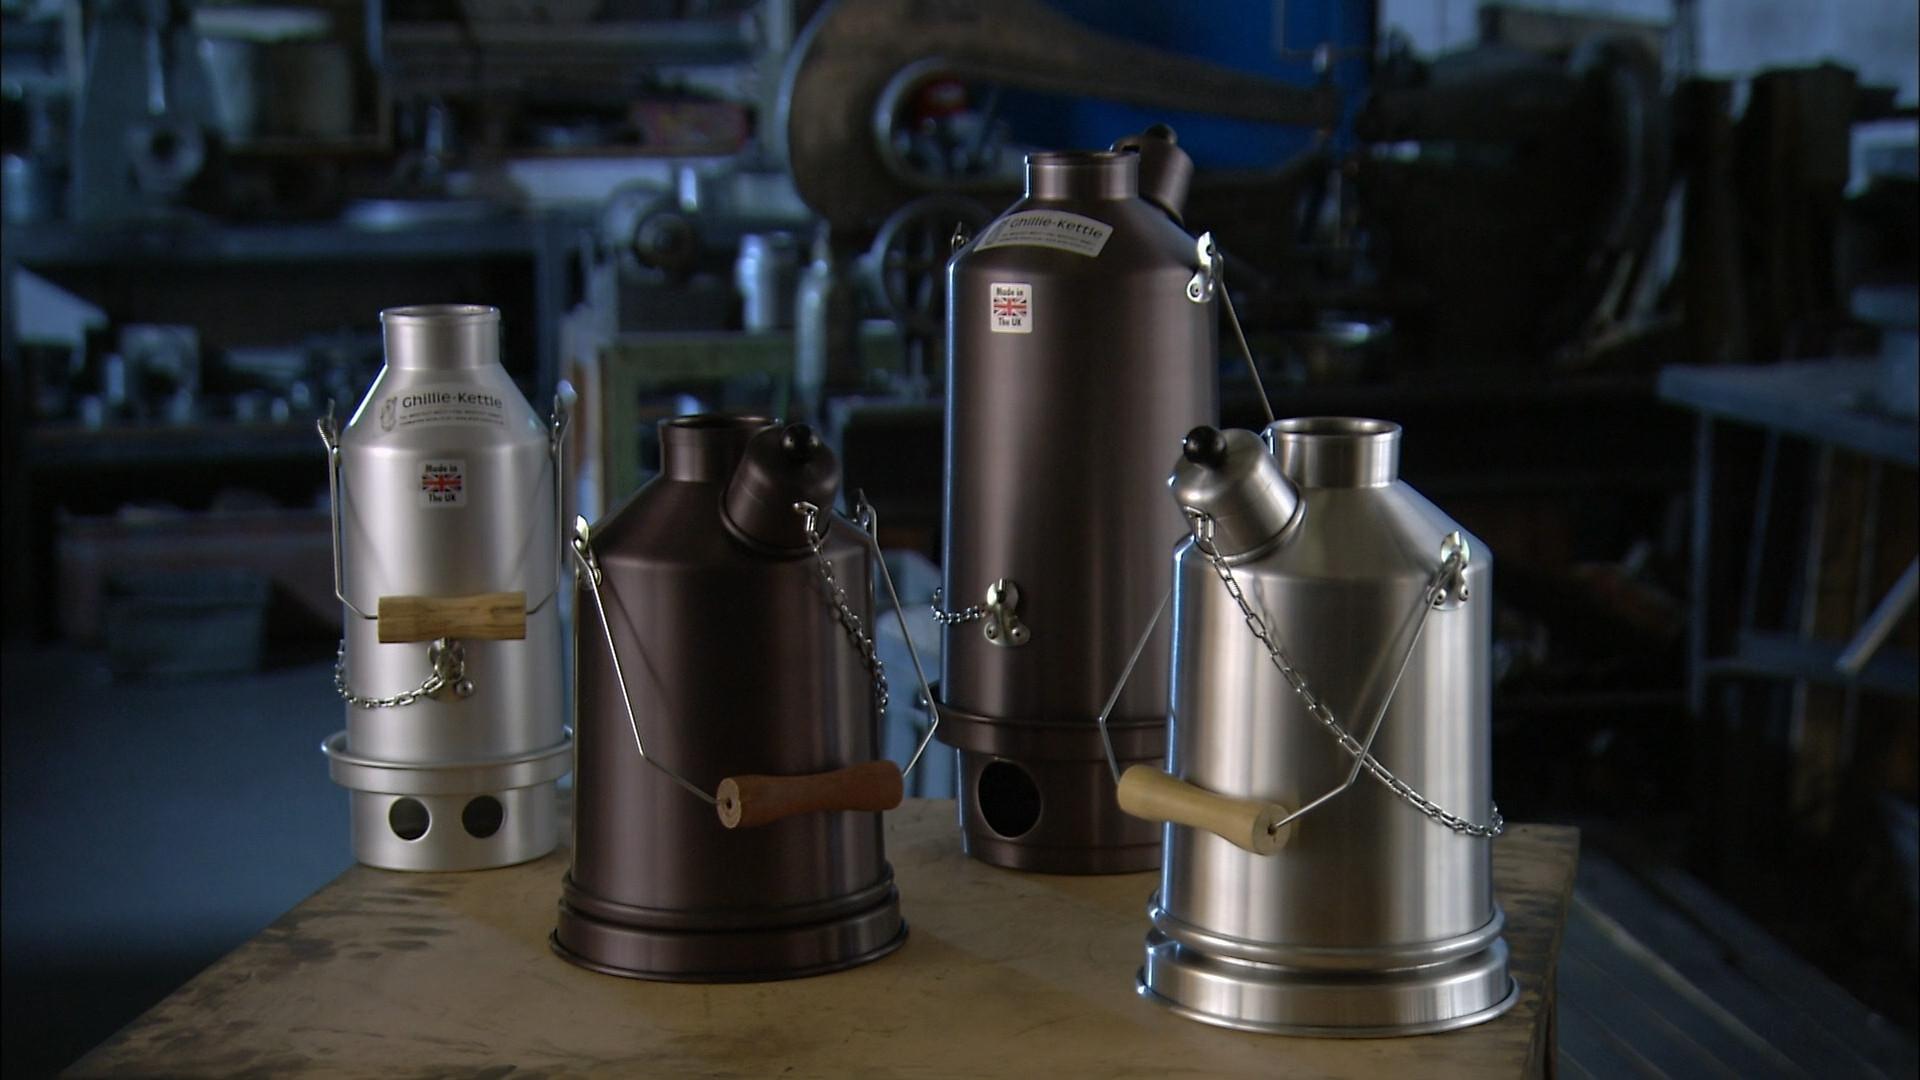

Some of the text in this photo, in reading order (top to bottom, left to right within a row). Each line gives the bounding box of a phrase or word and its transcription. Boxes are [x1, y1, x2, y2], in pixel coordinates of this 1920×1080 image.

[1009, 215, 1103, 238] Ghillie-Kettle
[996, 287, 1024, 296] Made in
[998, 317, 1022, 326] The UK
[402, 391, 503, 409] Ghillie-Kettle
[428, 492, 457, 502] The UK
